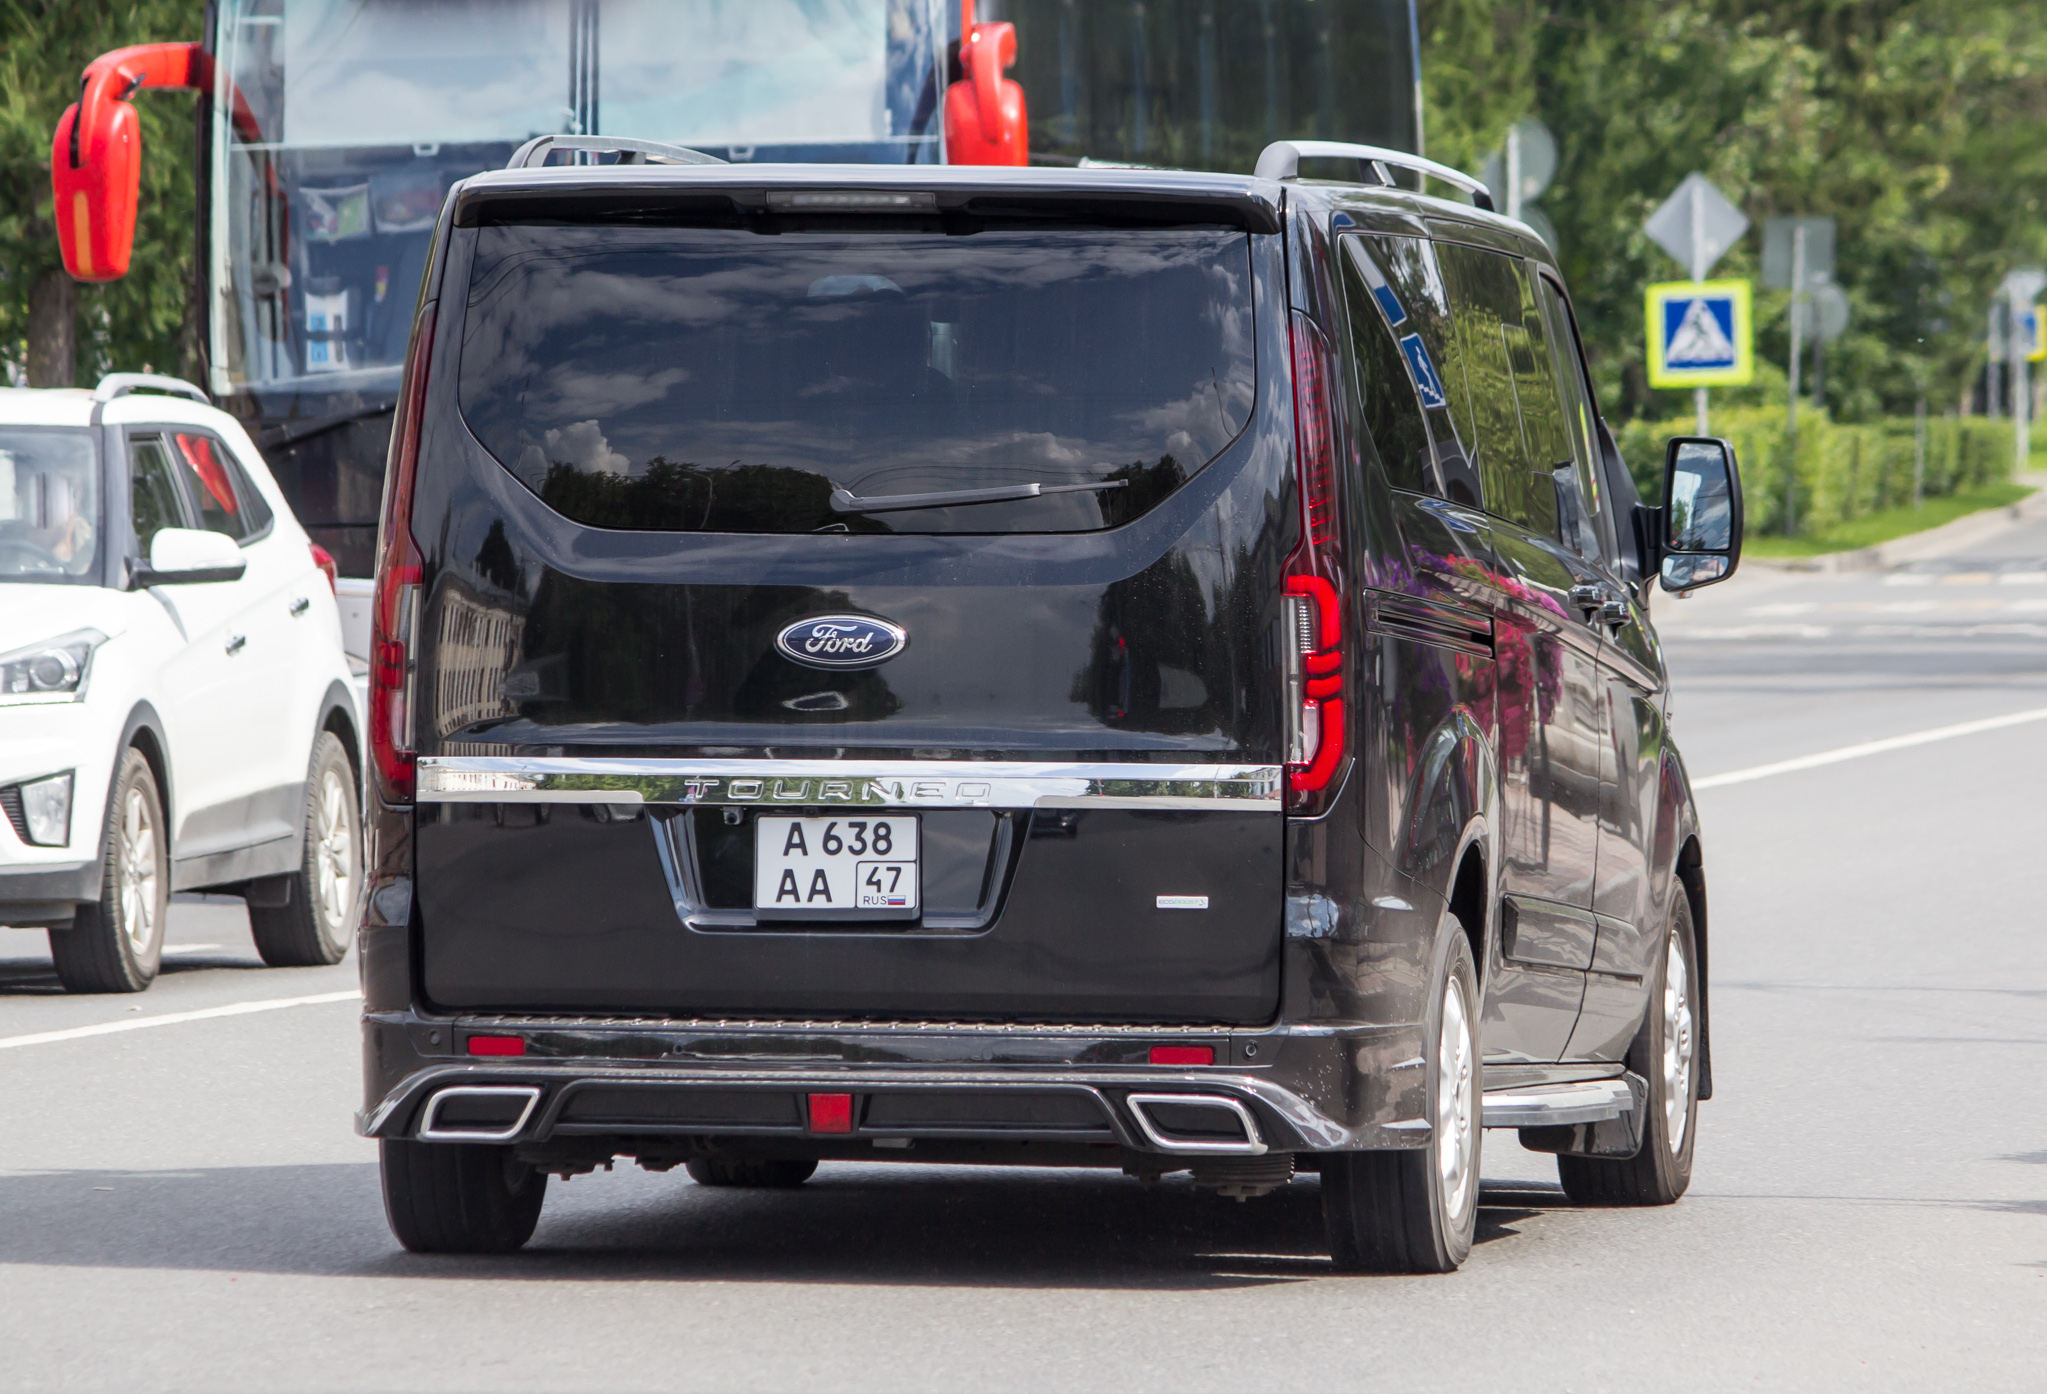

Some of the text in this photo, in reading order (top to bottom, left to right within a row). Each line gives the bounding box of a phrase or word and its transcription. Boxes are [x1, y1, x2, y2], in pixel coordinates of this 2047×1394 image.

[804, 623, 875, 653] Ford
[684, 778, 992, 801] TOURNEO
[782, 820, 893, 857] A 638
[775, 868, 833, 904] AA
[865, 866, 903, 894] 47
[862, 895, 888, 906] RUS
